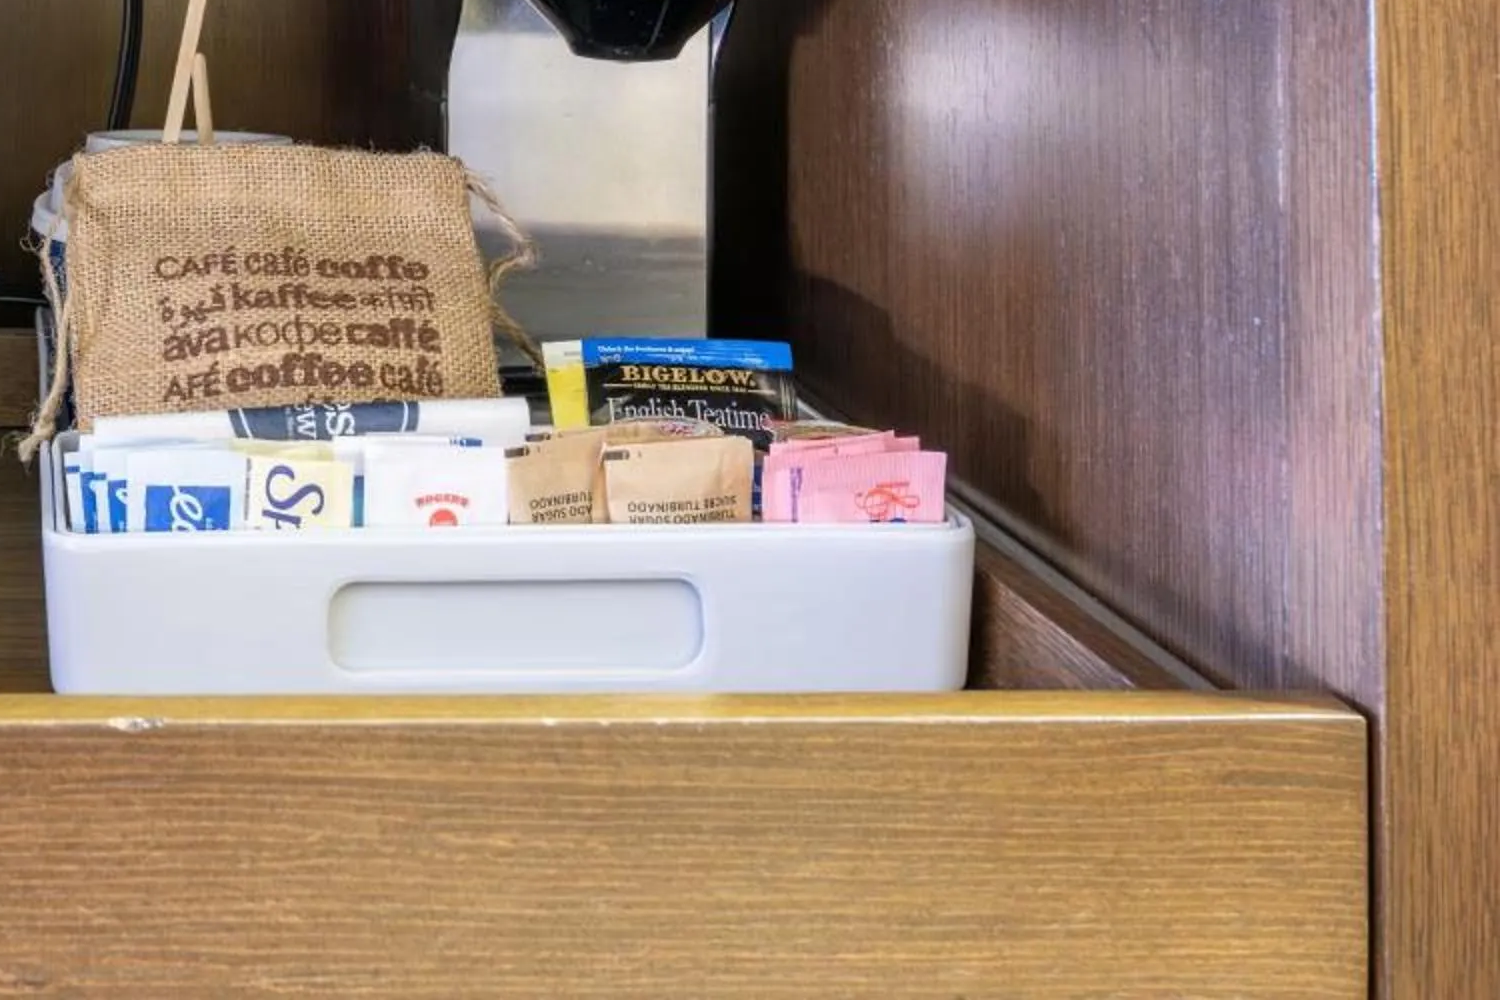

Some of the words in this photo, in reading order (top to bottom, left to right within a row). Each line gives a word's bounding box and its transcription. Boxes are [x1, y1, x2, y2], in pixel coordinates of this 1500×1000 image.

[155, 245, 238, 281] CAFÉ
[244, 246, 311, 277] café
[231, 281, 357, 311] kaffee
[235, 314, 343, 353] кофе
[226, 352, 375, 393] coffee
[380, 355, 444, 397] café
[605, 396, 685, 423] English
[688, 399, 772, 430] Teatime
[415, 493, 469, 508] ROGERS
[627, 500, 700, 513] TURBINADO
[704, 495, 738, 509] SUCRE
